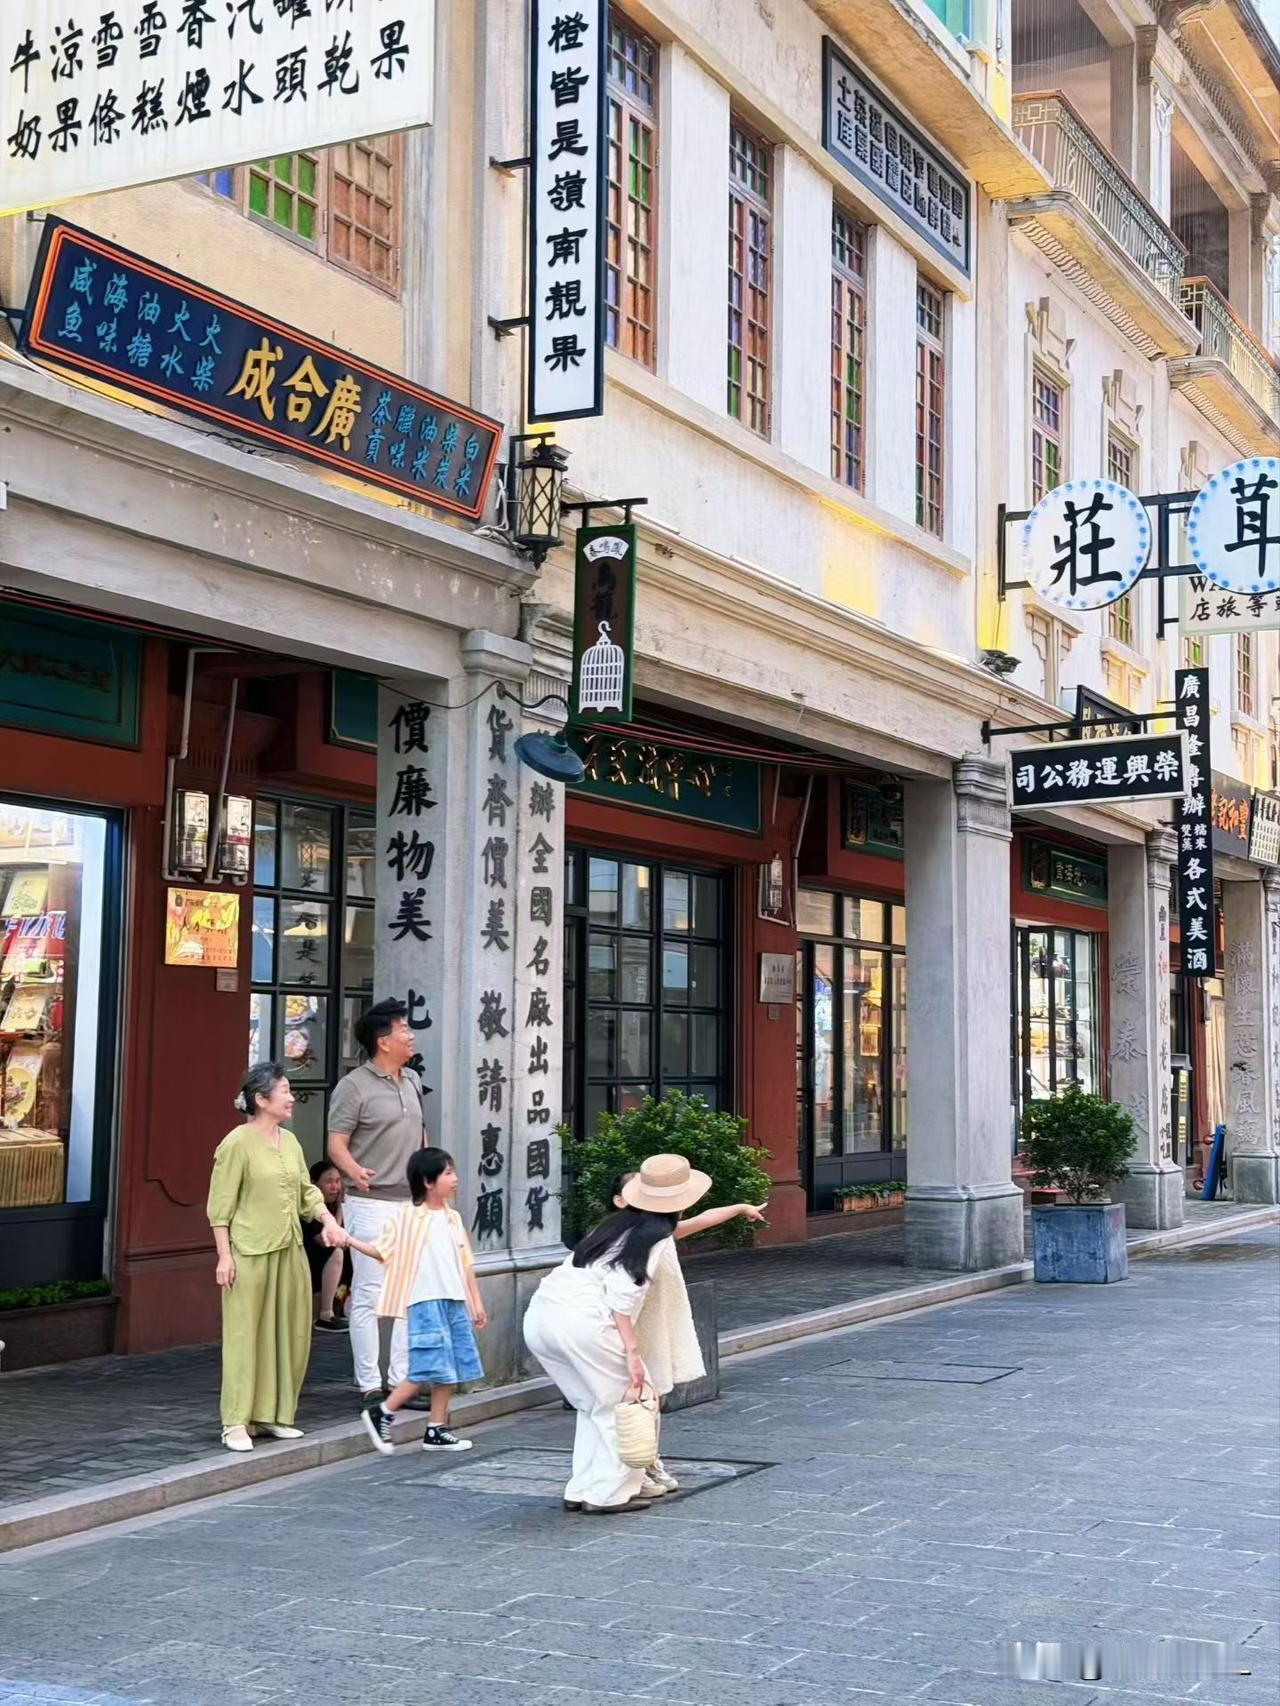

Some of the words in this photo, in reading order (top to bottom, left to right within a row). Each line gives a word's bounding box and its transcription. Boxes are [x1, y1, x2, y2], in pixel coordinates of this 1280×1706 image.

[7, 28, 42, 160] 牛奶
[88, 11, 126, 146] 雪條
[369, 0, 410, 80] 果
[544, 11, 589, 373] 橙皆是嶺南靚果
[1050, 492, 1123, 597] 莊
[1190, 594, 1280, 621] 等旅店
[385, 701, 438, 942] 價廉物美
[1183, 857, 1208, 970] 各式美酒
[526, 728, 556, 1232] 辦全國名廠出品國貨
